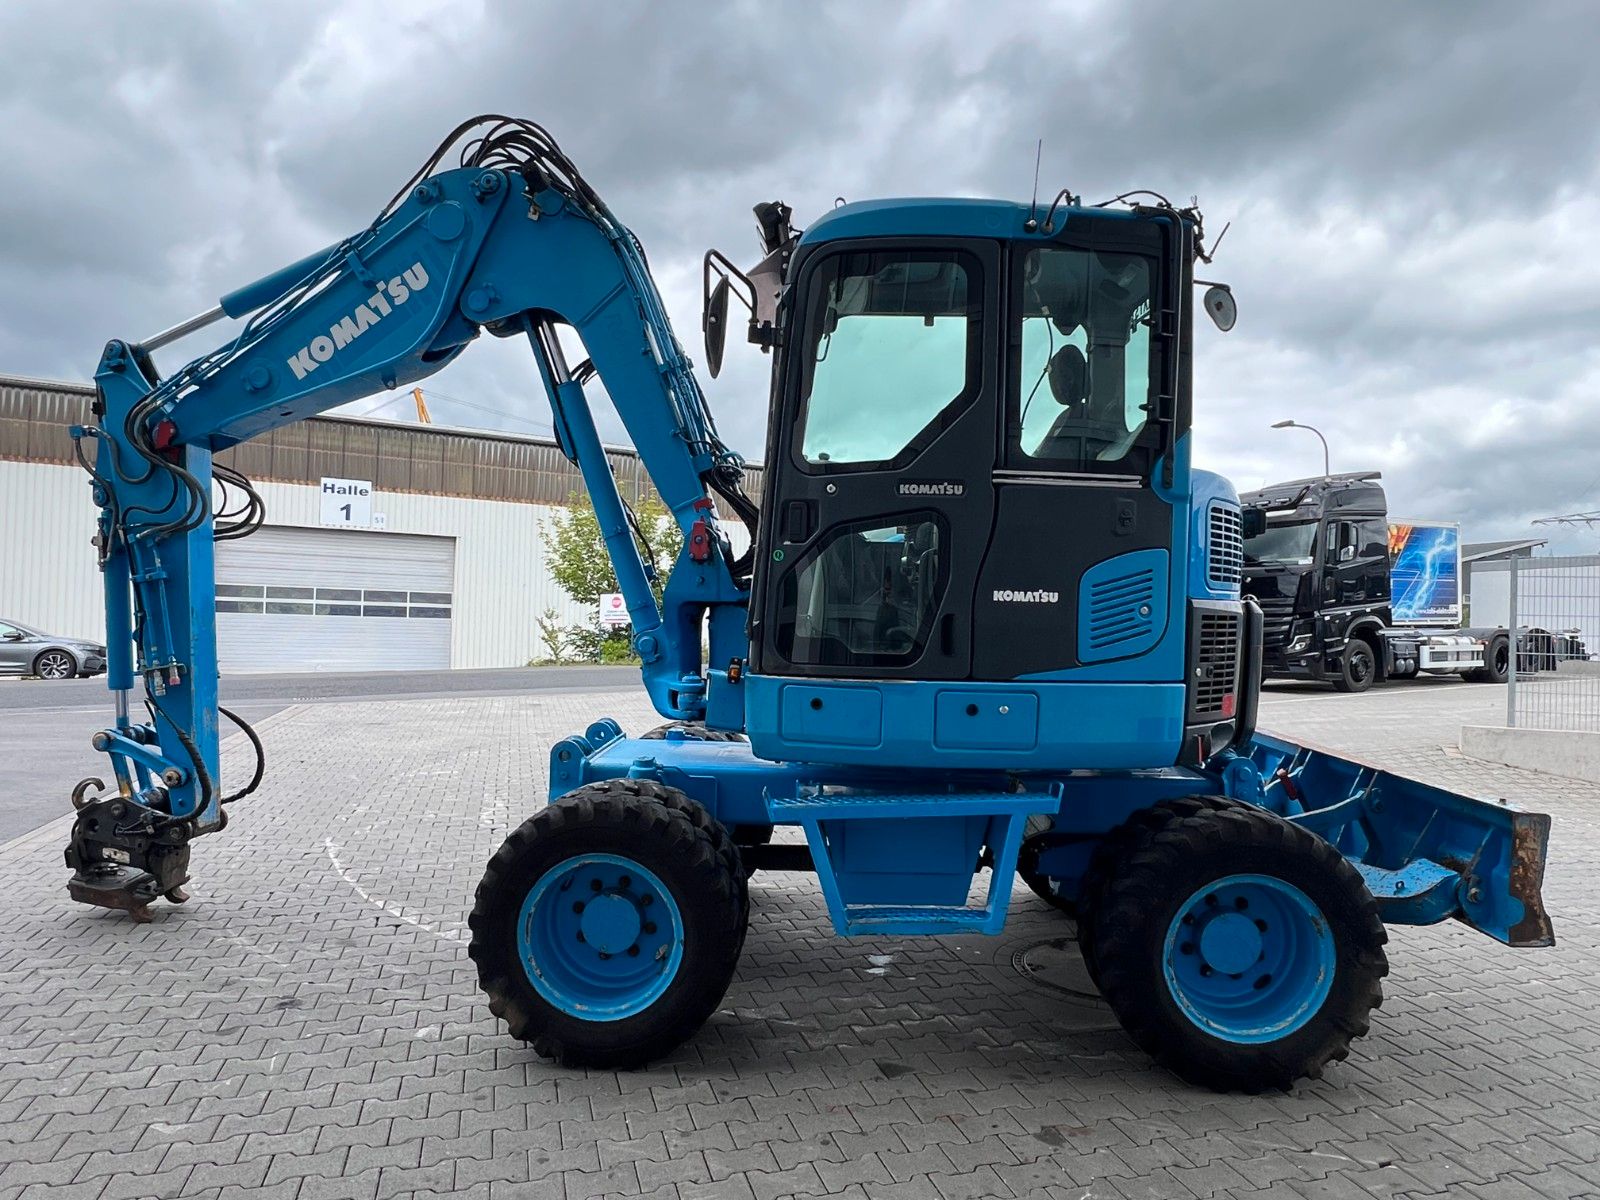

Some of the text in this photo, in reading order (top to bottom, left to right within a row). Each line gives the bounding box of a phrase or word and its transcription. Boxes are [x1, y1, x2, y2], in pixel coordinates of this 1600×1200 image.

[287, 262, 429, 380] KOMATSU
[323, 483, 369, 496] Halle
[900, 482, 963, 495] KOMATSU
[340, 503, 352, 521] 1
[993, 589, 1059, 603] KOMATSU
